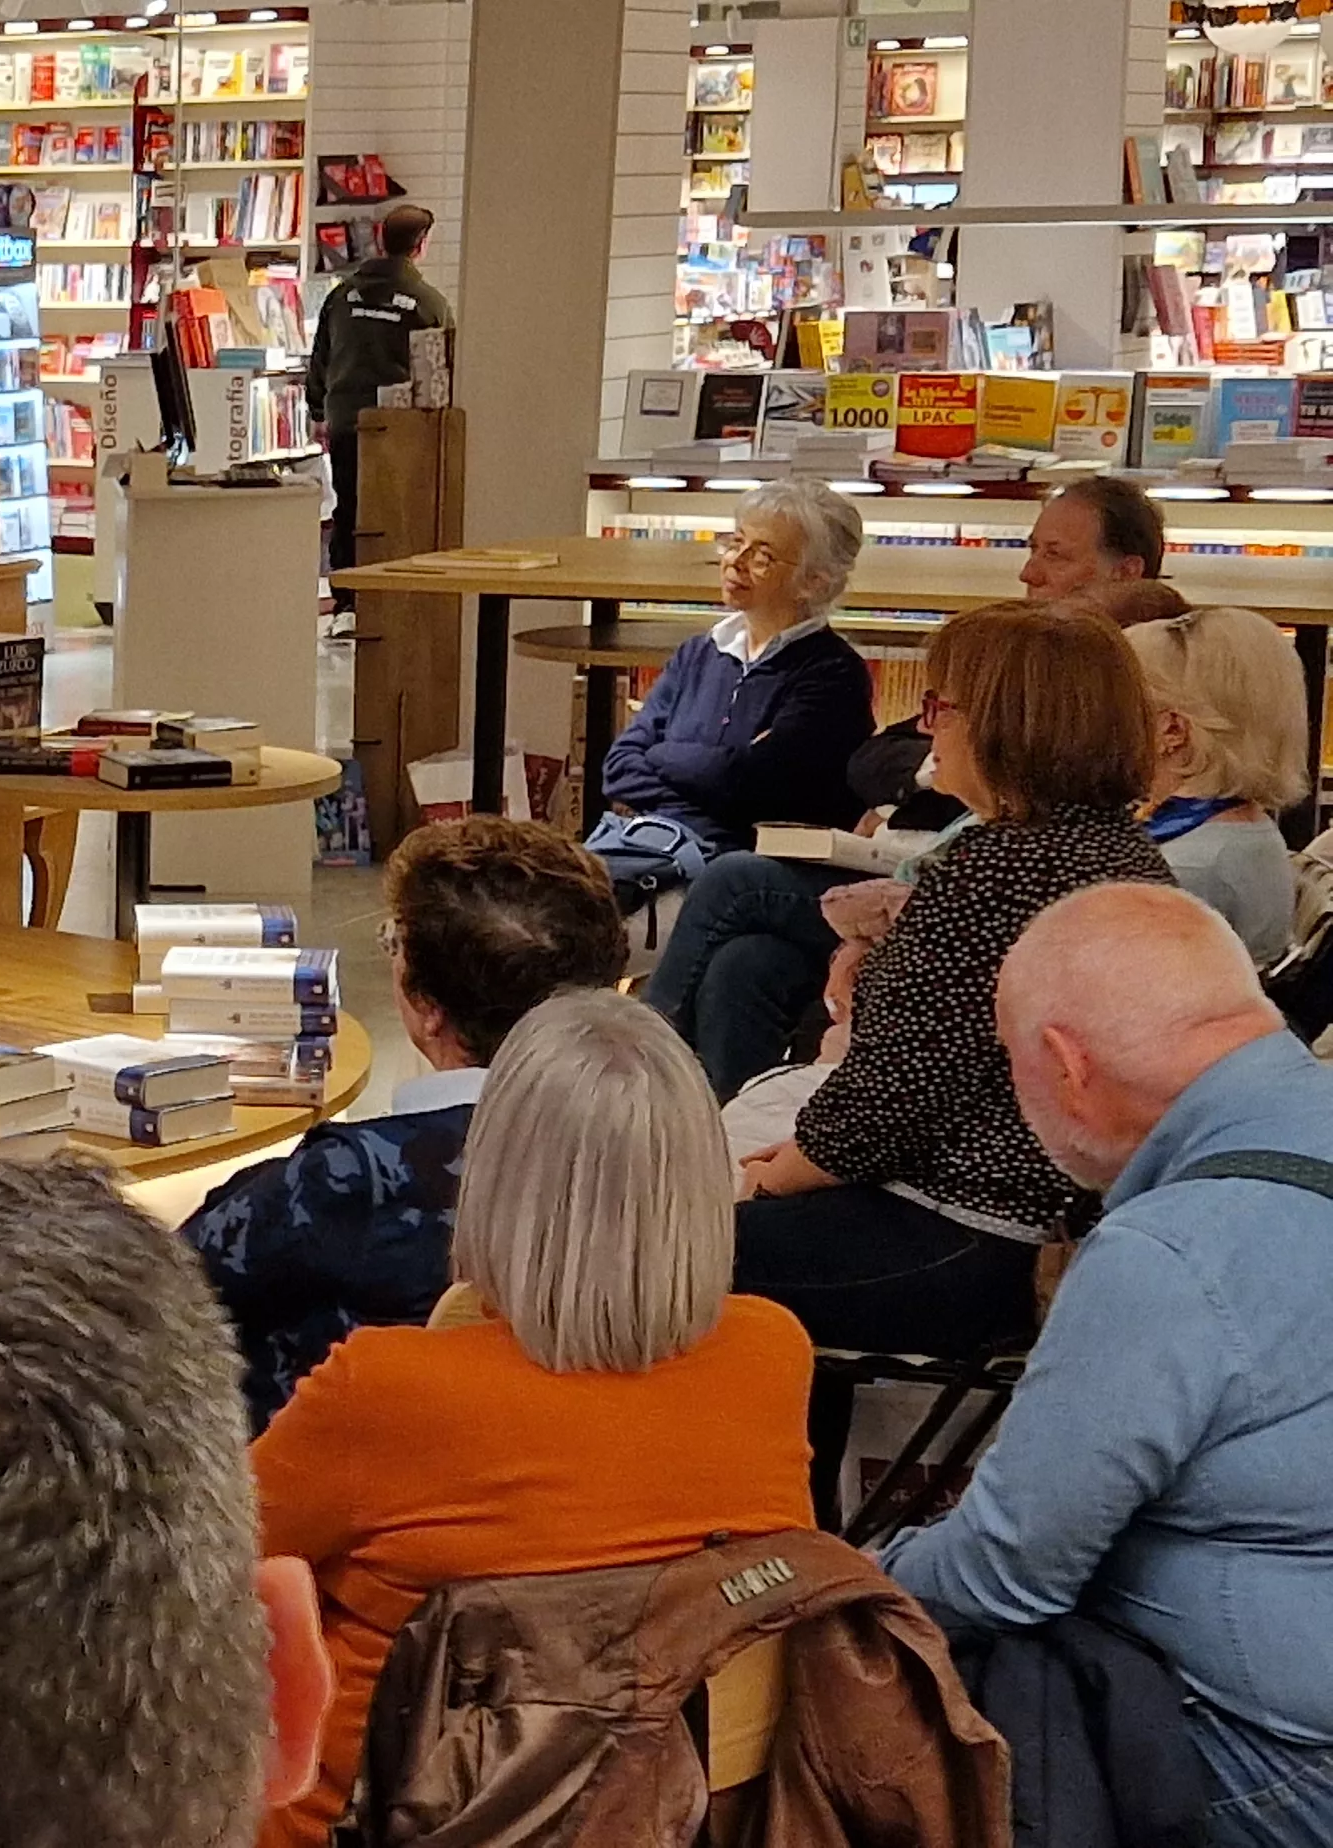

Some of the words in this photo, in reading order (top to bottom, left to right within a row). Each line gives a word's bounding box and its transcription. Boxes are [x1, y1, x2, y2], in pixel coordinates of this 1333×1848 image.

[100, 374, 118, 449] Diseño
[226, 376, 248, 461] tografía
[831, 407, 889, 428] 1.000
[913, 411, 956, 424] LPAC
